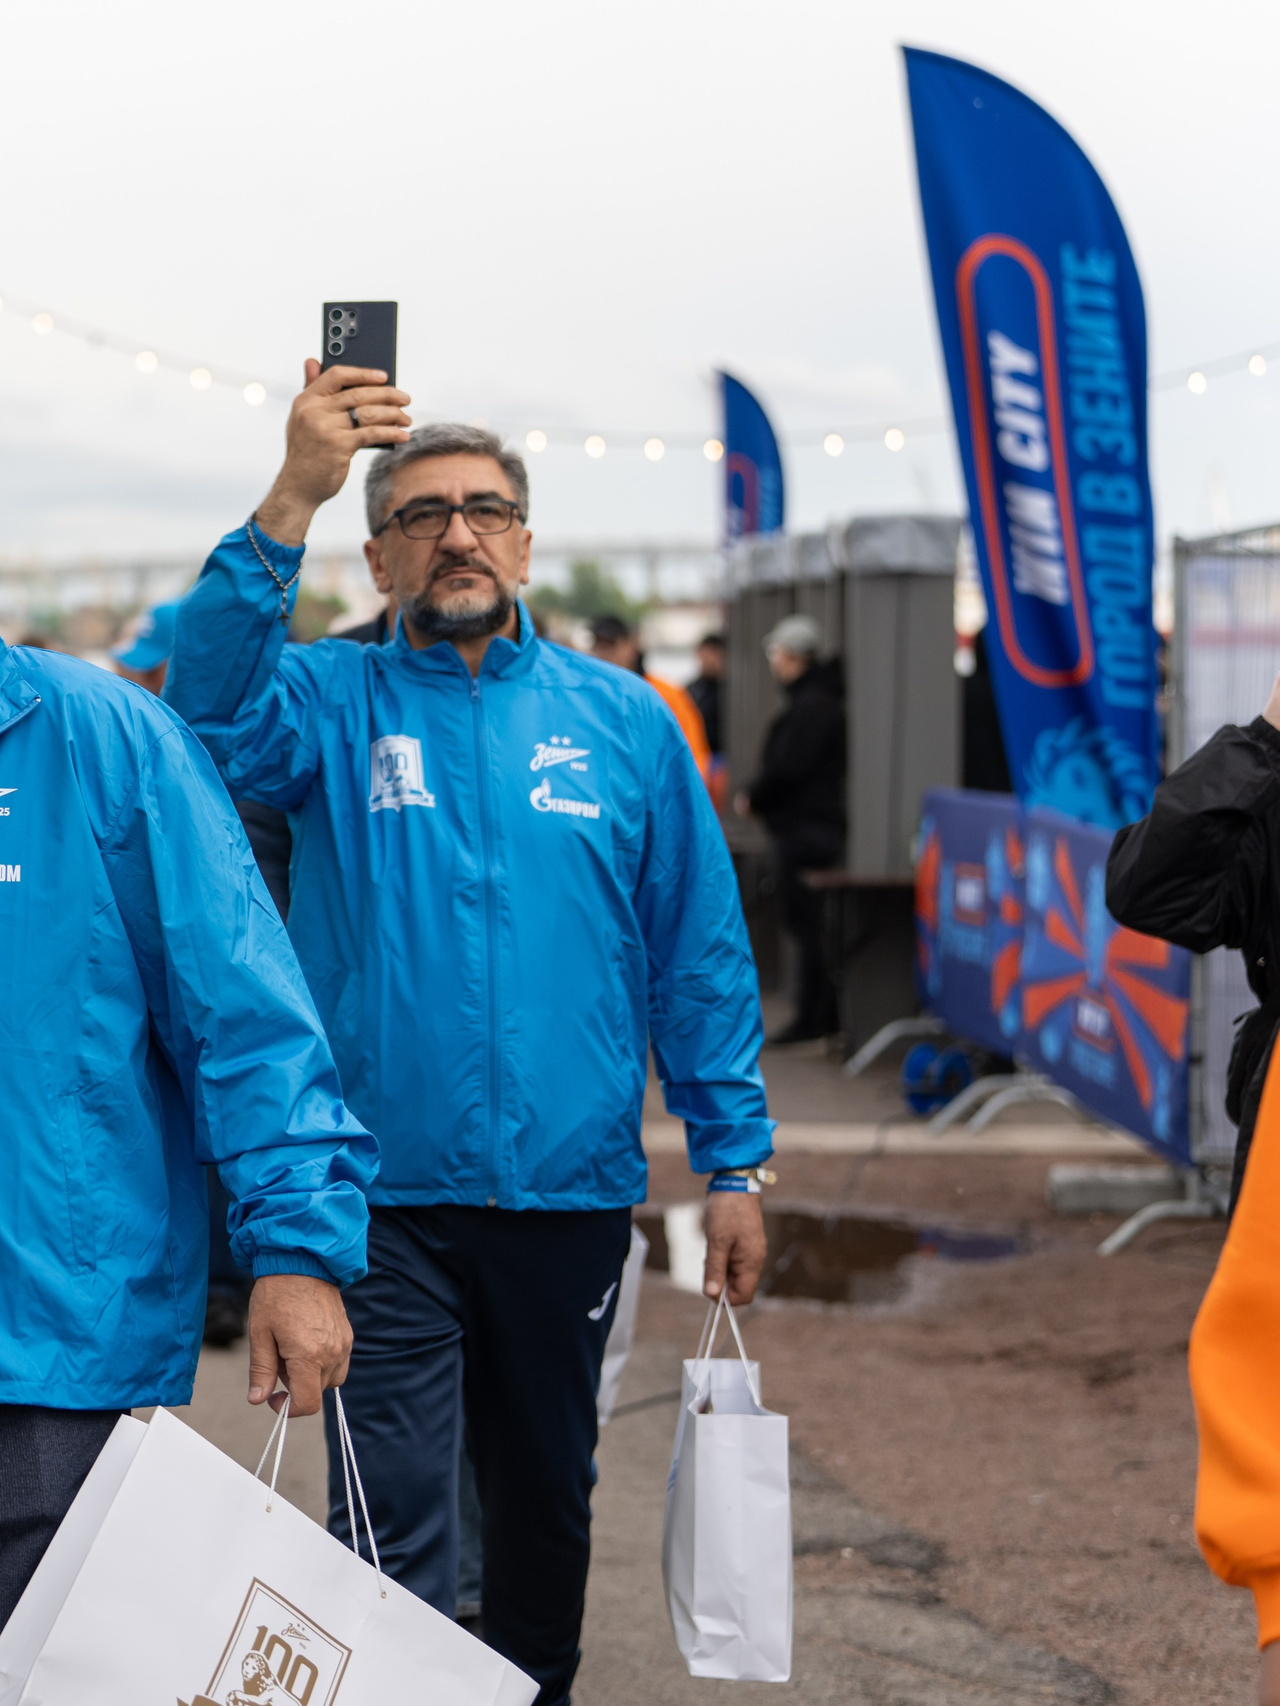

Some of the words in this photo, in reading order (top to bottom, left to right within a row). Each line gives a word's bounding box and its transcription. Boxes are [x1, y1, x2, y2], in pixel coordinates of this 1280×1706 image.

[987, 329, 1049, 472] CITY
[1060, 242, 1137, 466] ЗЕНИТЕ
[1078, 471, 1141, 516] В
[1082, 525, 1148, 708] ГОРОД
